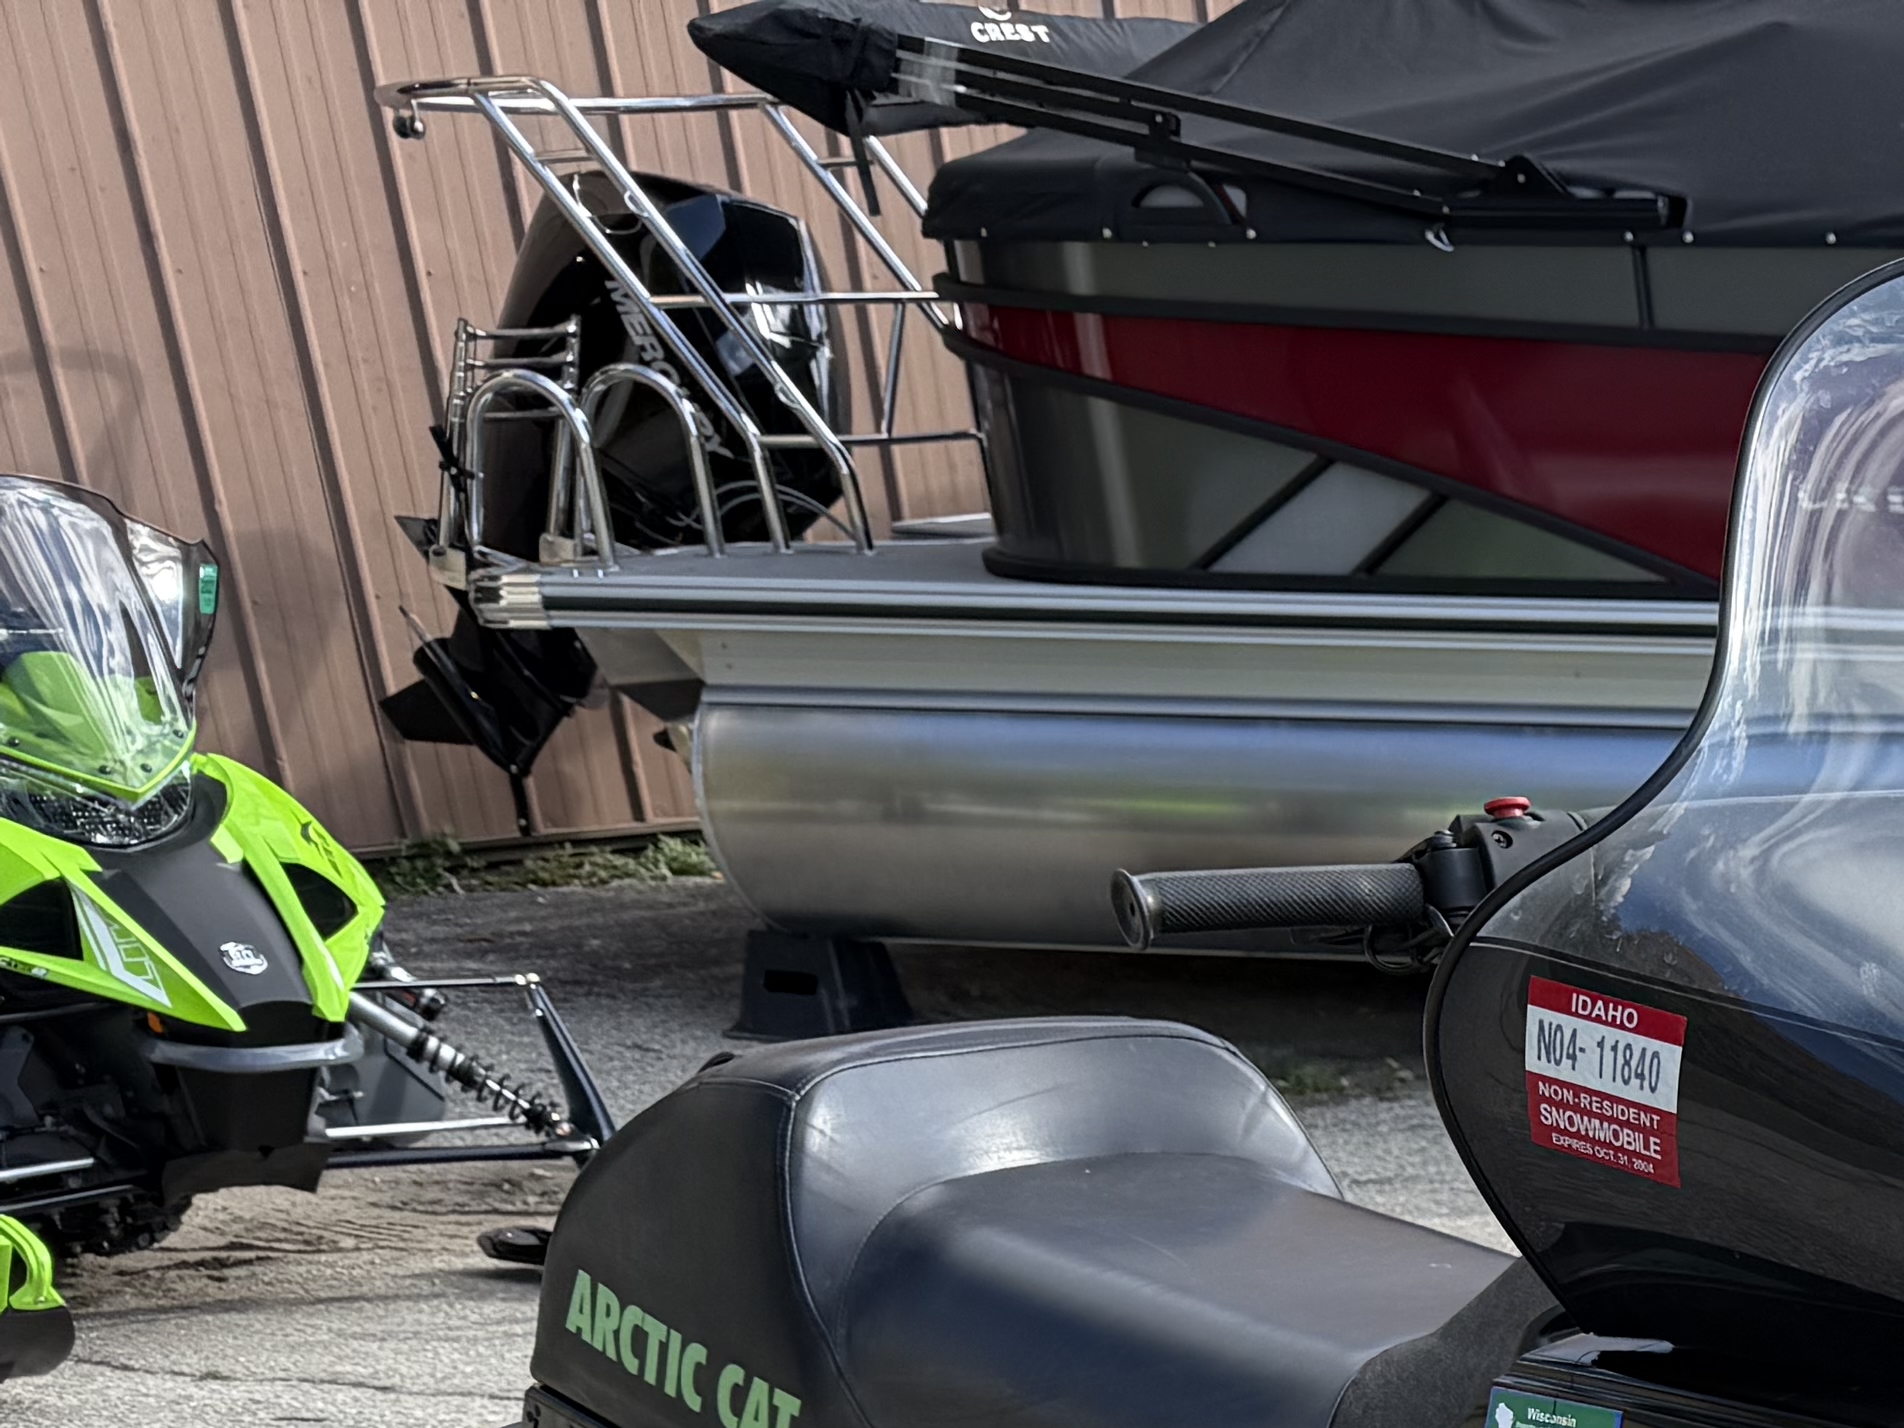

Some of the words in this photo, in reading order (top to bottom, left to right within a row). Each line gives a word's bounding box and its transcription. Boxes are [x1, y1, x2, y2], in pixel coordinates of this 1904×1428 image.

[970, 22, 1050, 43] CREST
[604, 280, 735, 459] MERCRY
[1572, 993, 1639, 1029] IDAHO
[1597, 1035, 1661, 1093] 11840
[1538, 1081, 1661, 1129] NON-RESIDENT
[1540, 1104, 1661, 1160] SNOWMOBILE
[1552, 1133, 1593, 1155] EXPIRES
[565, 1269, 708, 1412] ARCTIC
[1527, 1407, 1577, 1428] Wisconsin
